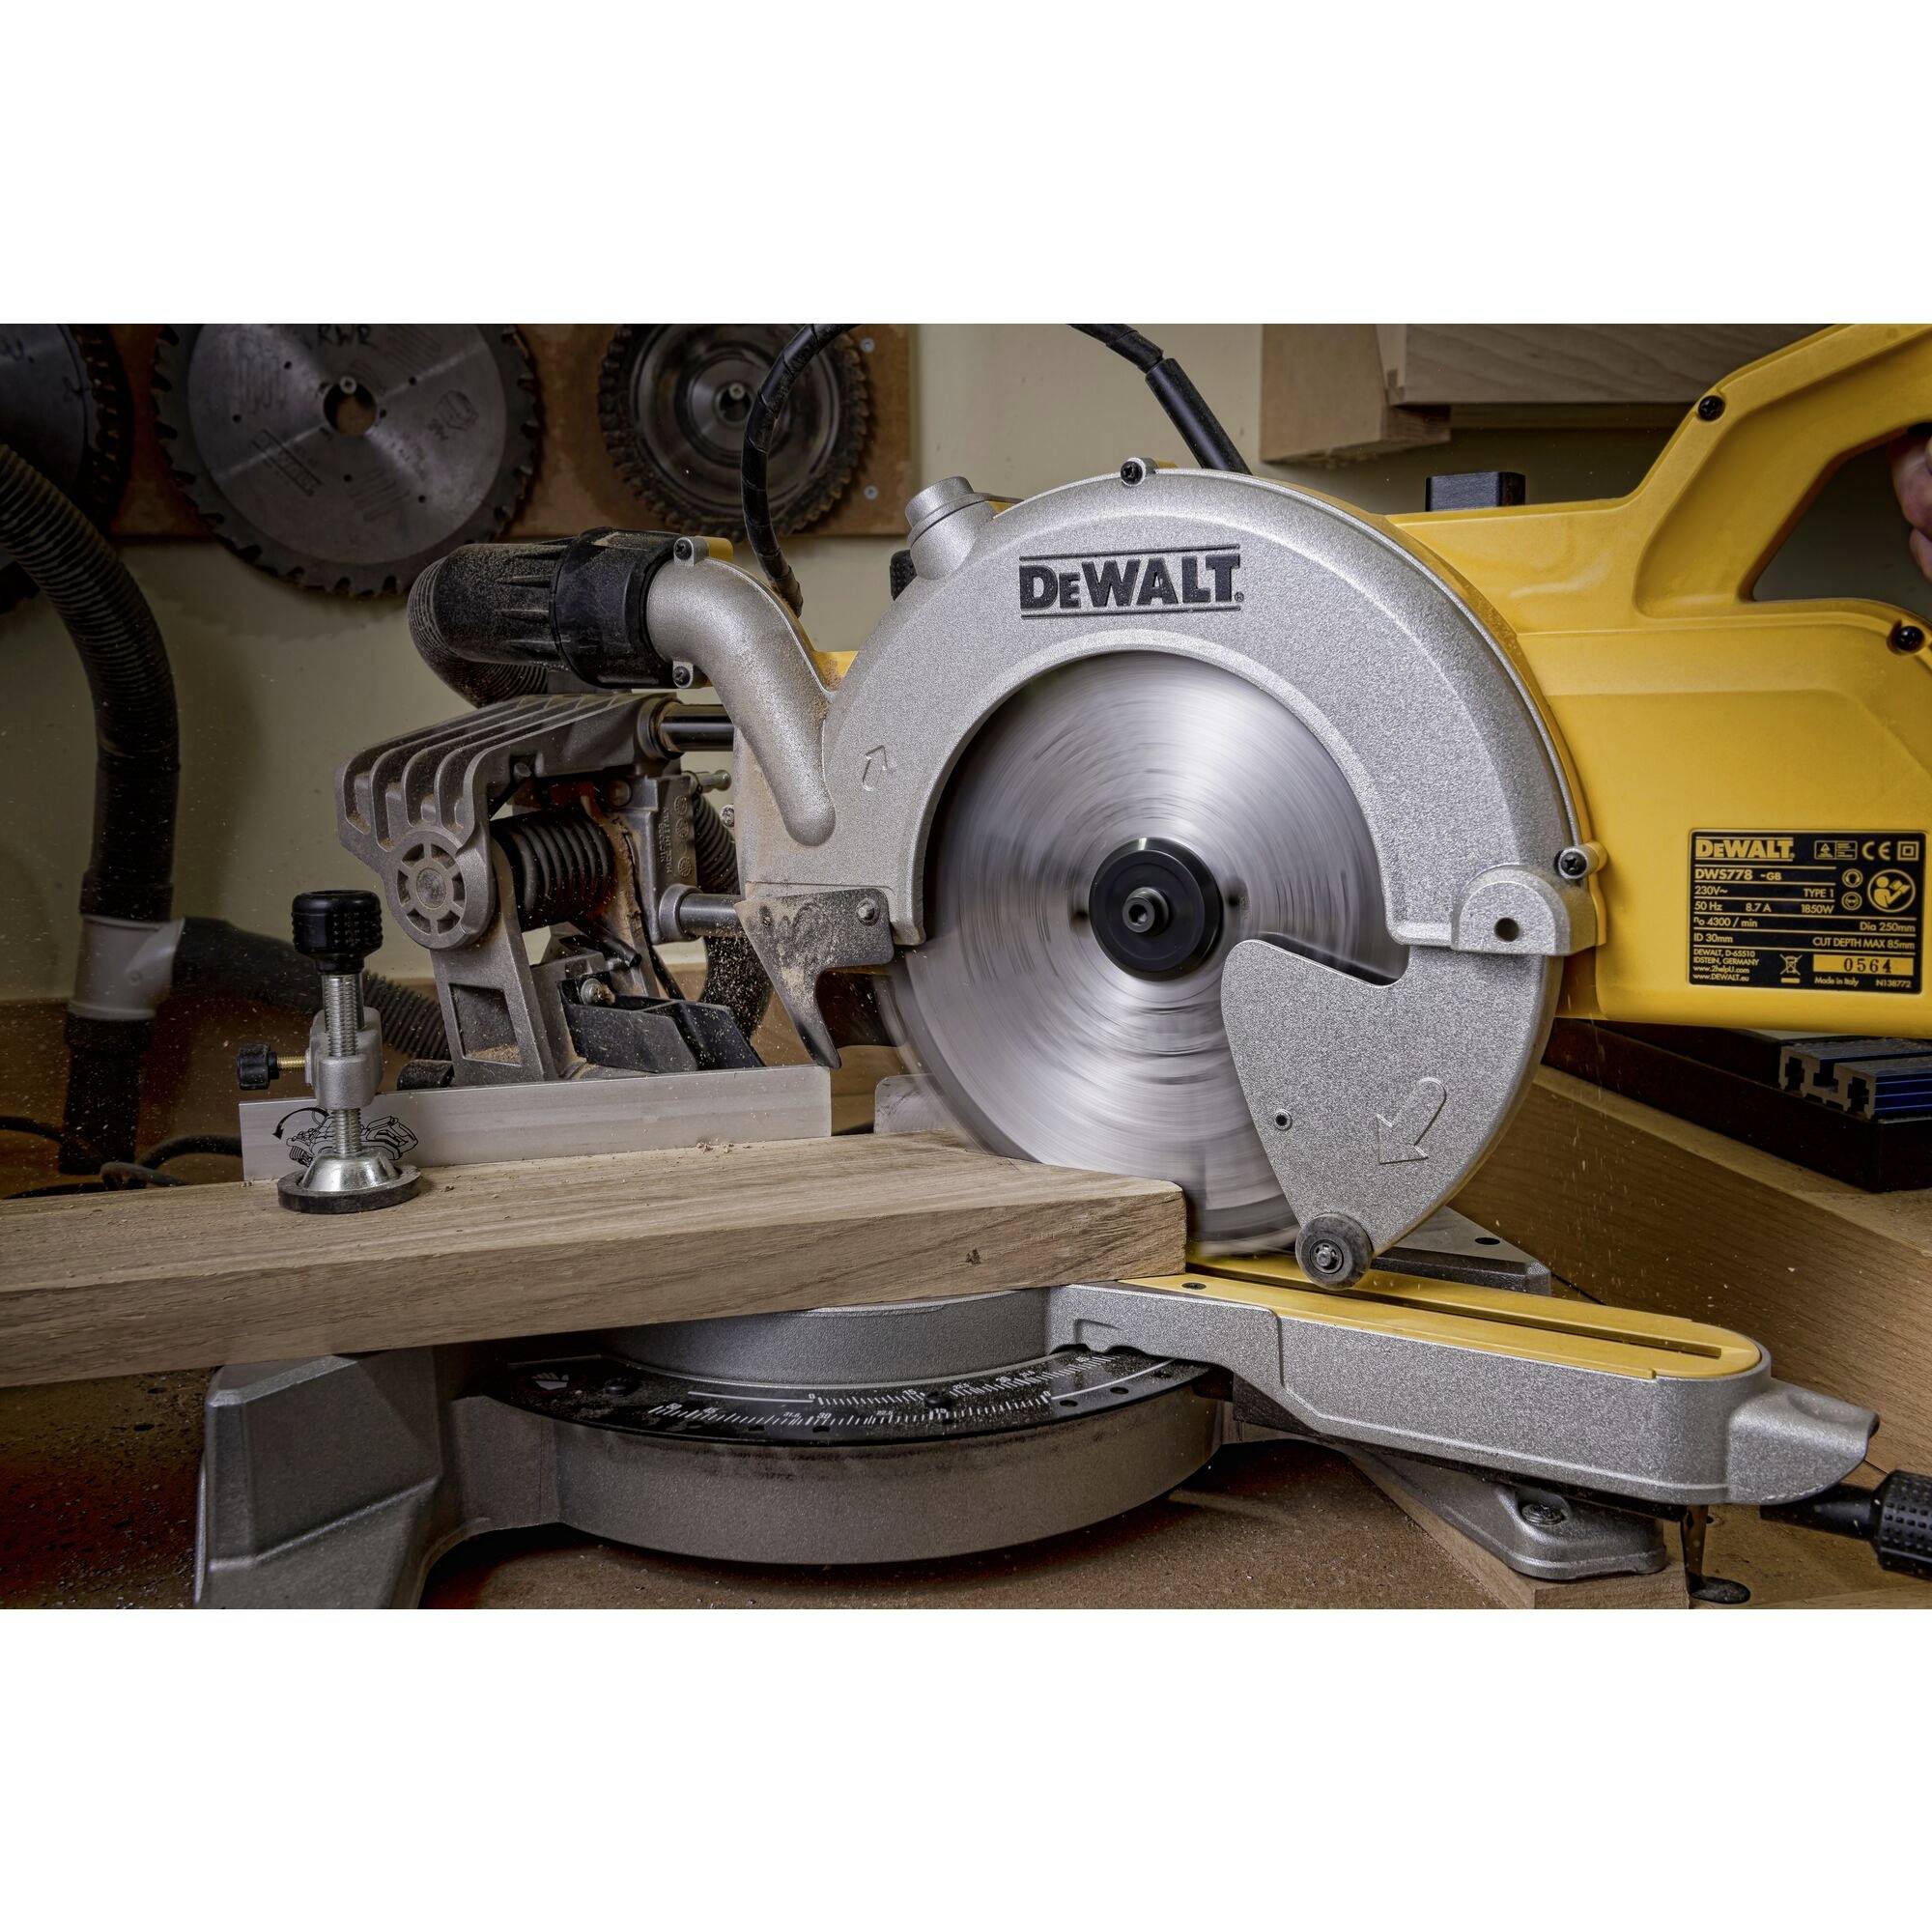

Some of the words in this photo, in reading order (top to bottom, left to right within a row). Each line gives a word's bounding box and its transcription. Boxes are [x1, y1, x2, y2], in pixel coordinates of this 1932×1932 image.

[1694, 868, 1753, 880] DWS778
[1804, 888, 1827, 898] TYPE
[1831, 889, 1834, 898] 1
[1694, 900, 1708, 911] 50
[1709, 901, 1722, 911] Hz
[1745, 902, 1761, 912] 8.7
[1762, 903, 1772, 912] A
[1801, 903, 1835, 914] 1850W
[1706, 917, 1731, 926] 4300
[1741, 918, 1758, 927] min
[1860, 921, 1877, 931] Dia
[1879, 922, 1916, 932] 250mm
[1693, 932, 1704, 942] ID
[1705, 933, 1733, 943] 30mm
[1812, 936, 1832, 947] CUT
[1833, 937, 1861, 948] DEPTH
[1862, 938, 1886, 949] MAX
[1887, 939, 1916, 950] 85mm
[1693, 948, 1724, 957] DEWALT,
[1693, 956, 1722, 965] IDSTEIN,
[1722, 957, 1760, 966] GERMANY
[1692, 973, 1749, 981] www.DEWALT.eu
[1814, 977, 1835, 985] Made
[1844, 977, 1859, 987] Italy
